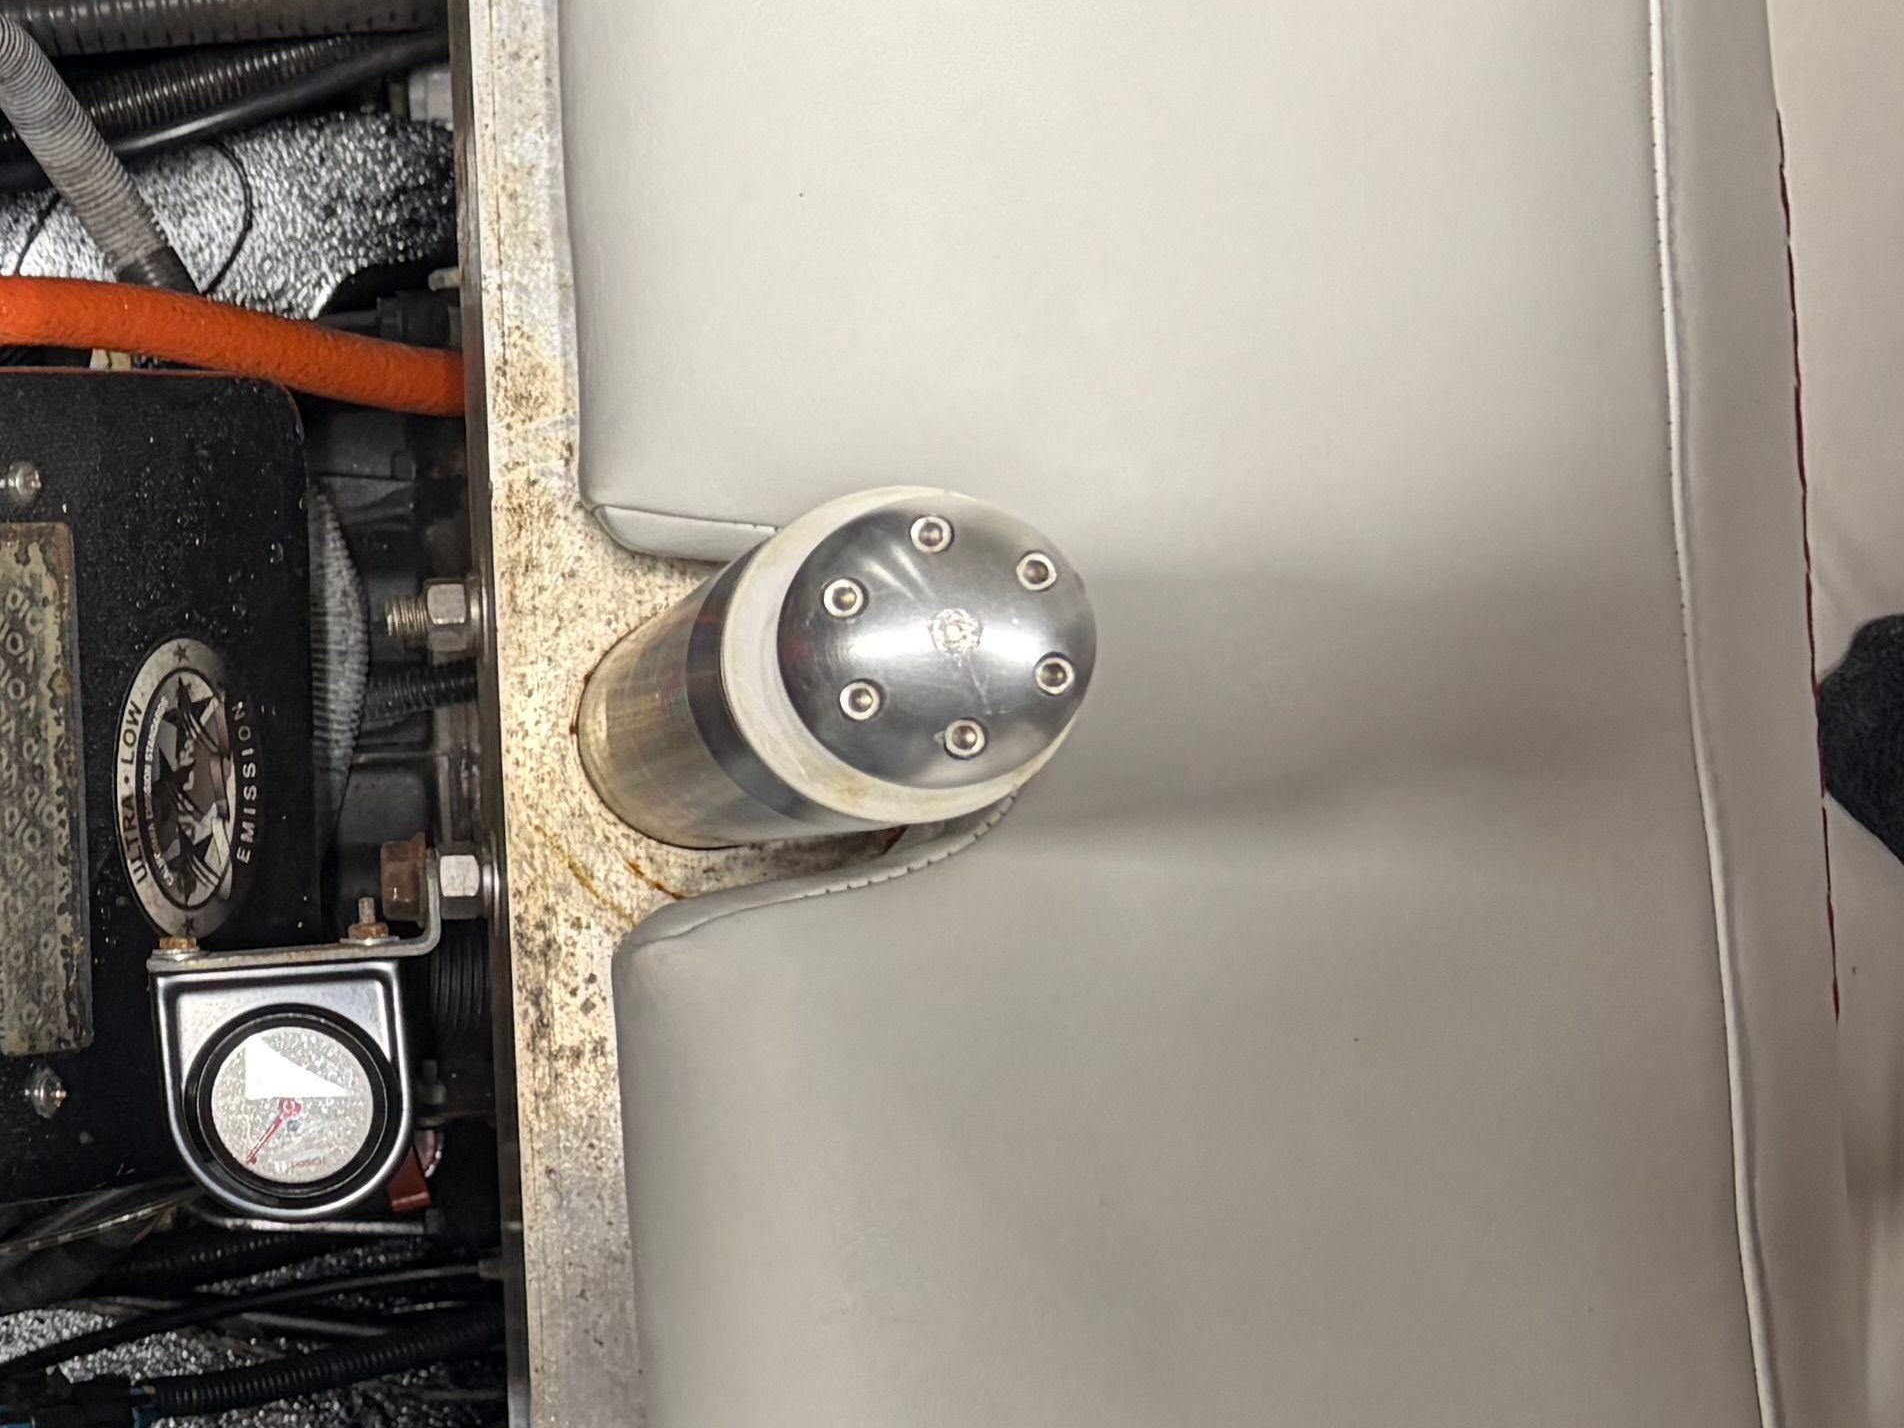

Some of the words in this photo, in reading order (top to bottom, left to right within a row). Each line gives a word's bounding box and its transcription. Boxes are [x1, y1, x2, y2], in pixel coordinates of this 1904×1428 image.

[120, 700, 143, 766] LOW
[232, 700, 259, 864] EMISSION
[120, 794, 149, 885] ULTRA
